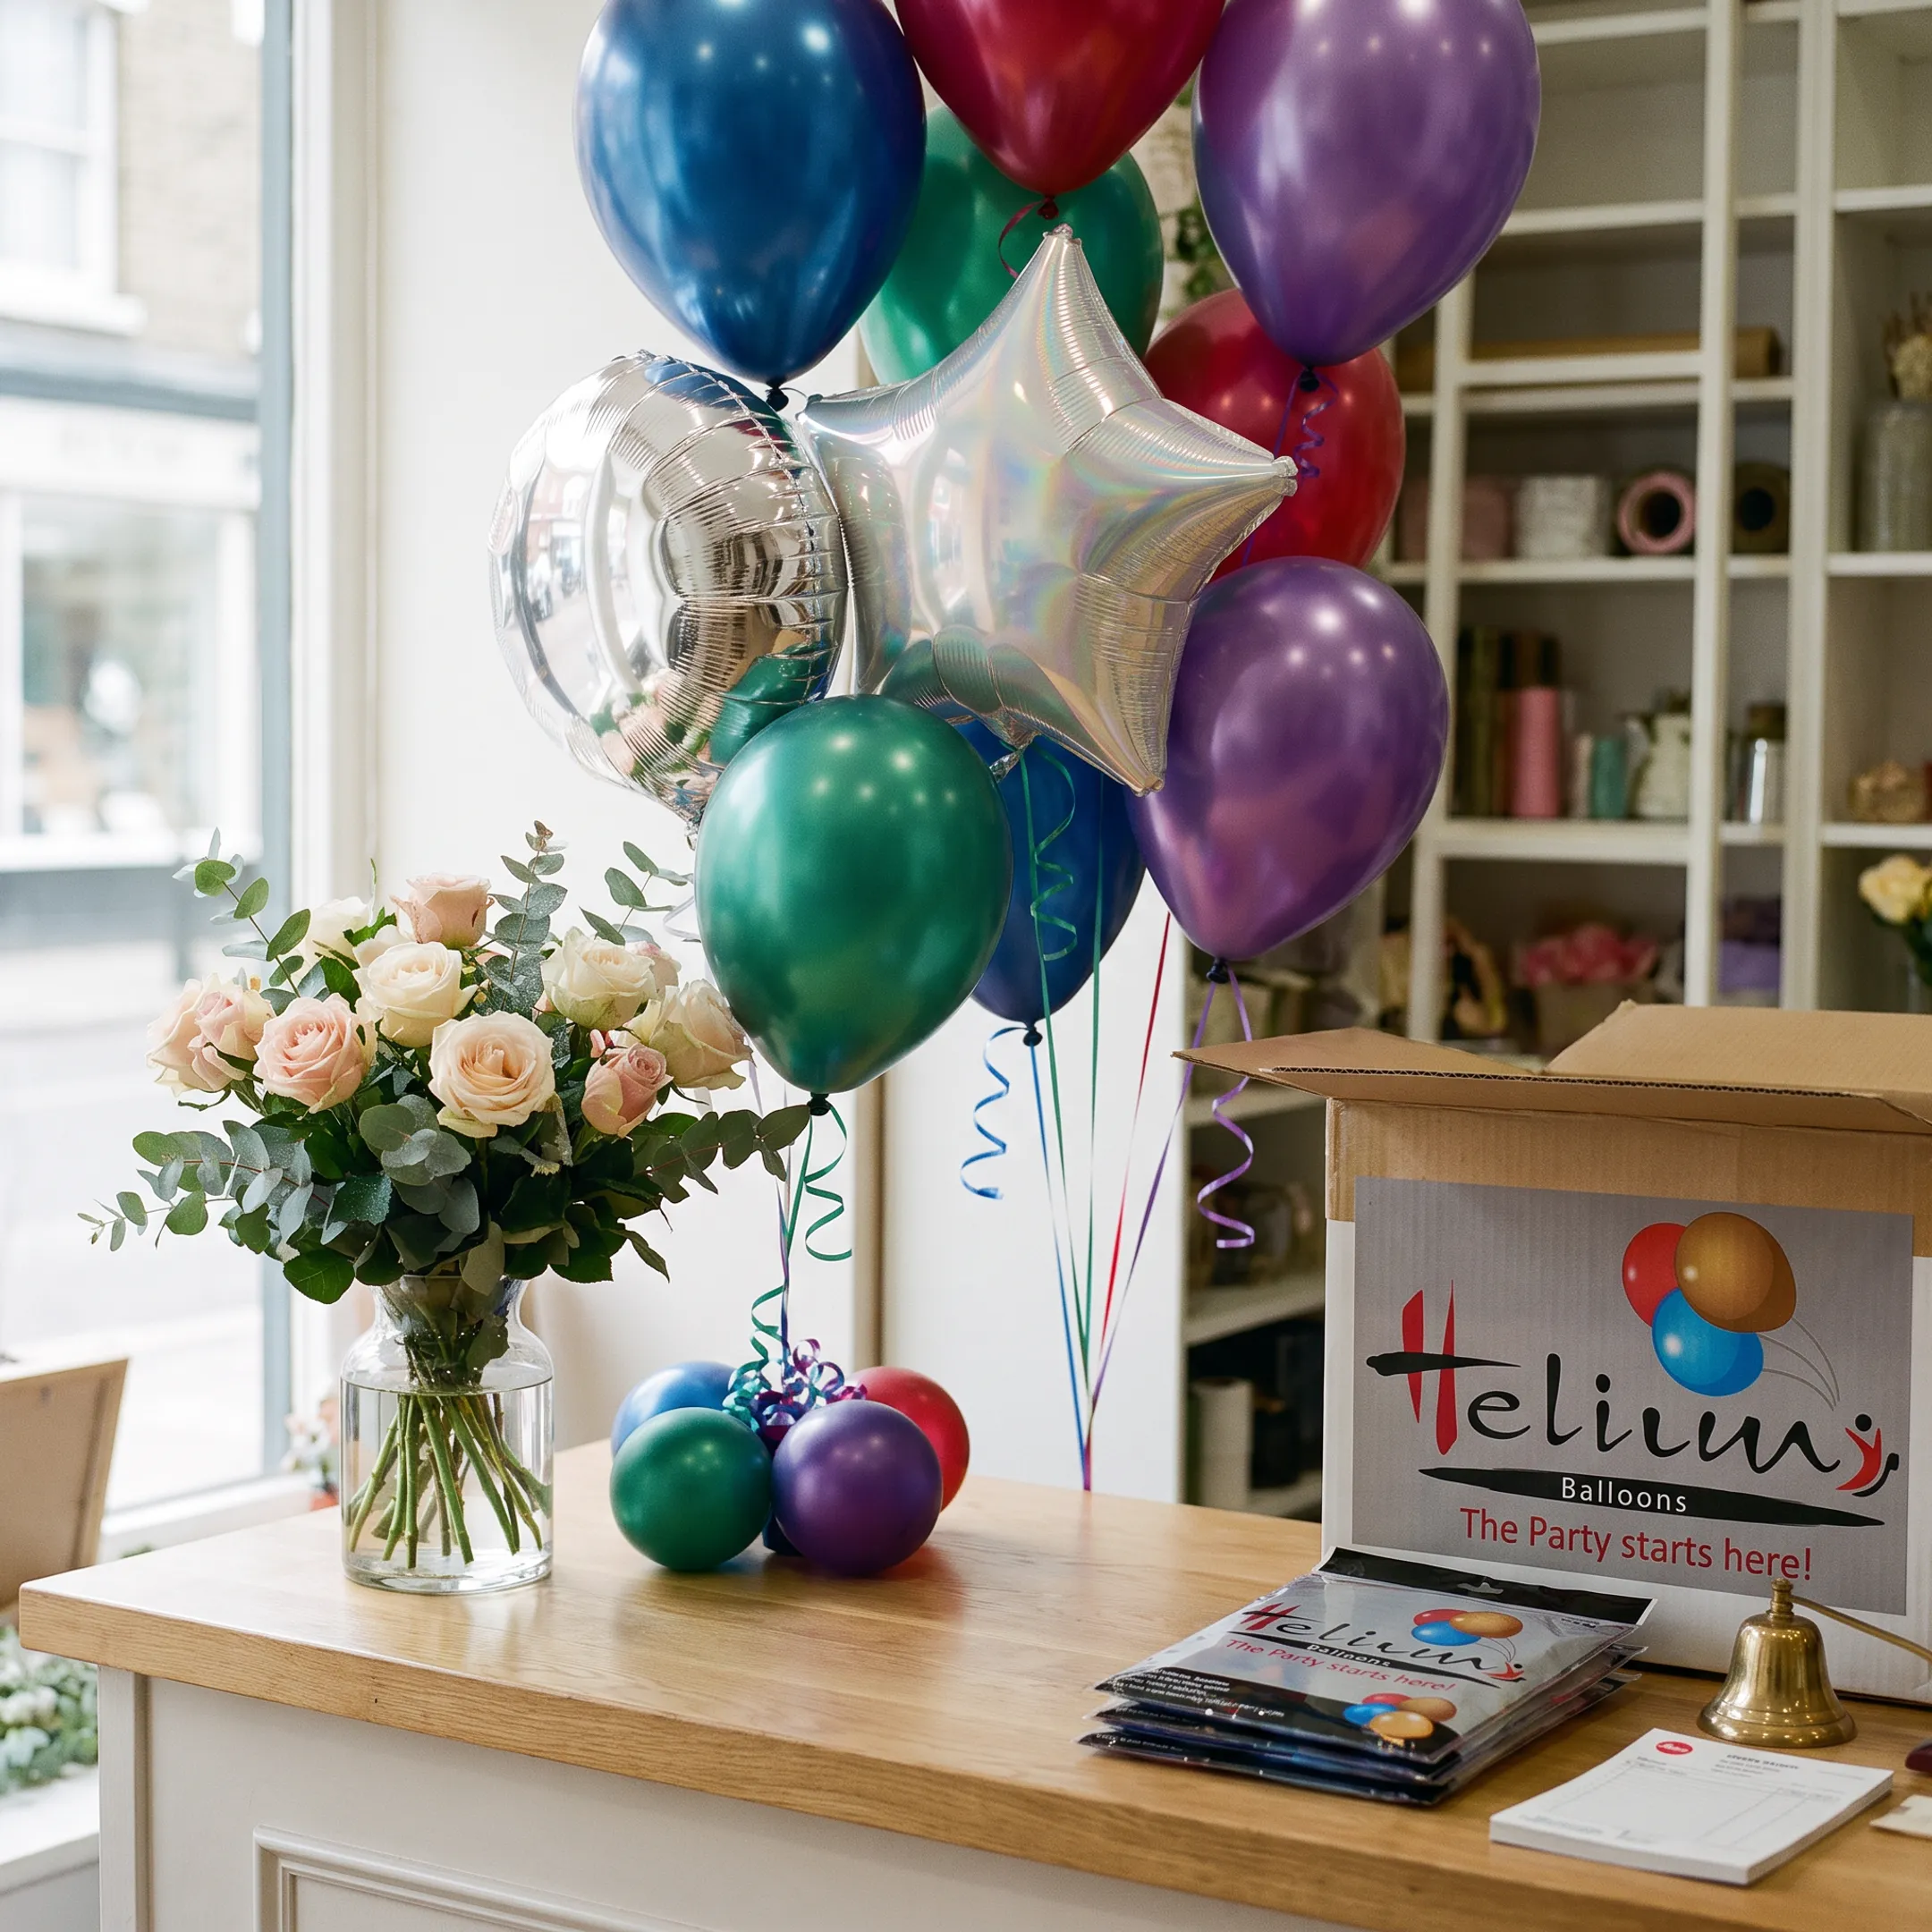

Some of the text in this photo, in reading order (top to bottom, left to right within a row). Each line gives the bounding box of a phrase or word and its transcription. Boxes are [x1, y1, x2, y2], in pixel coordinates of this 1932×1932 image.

[1365, 1278, 1842, 1475] Helium
[1561, 1476, 1688, 1513] Balloons
[1460, 1506, 1812, 1581] The Party starts here!
[1226, 1639, 1457, 1691] The Party starts here!
[1240, 1602, 1498, 1671] Helium
